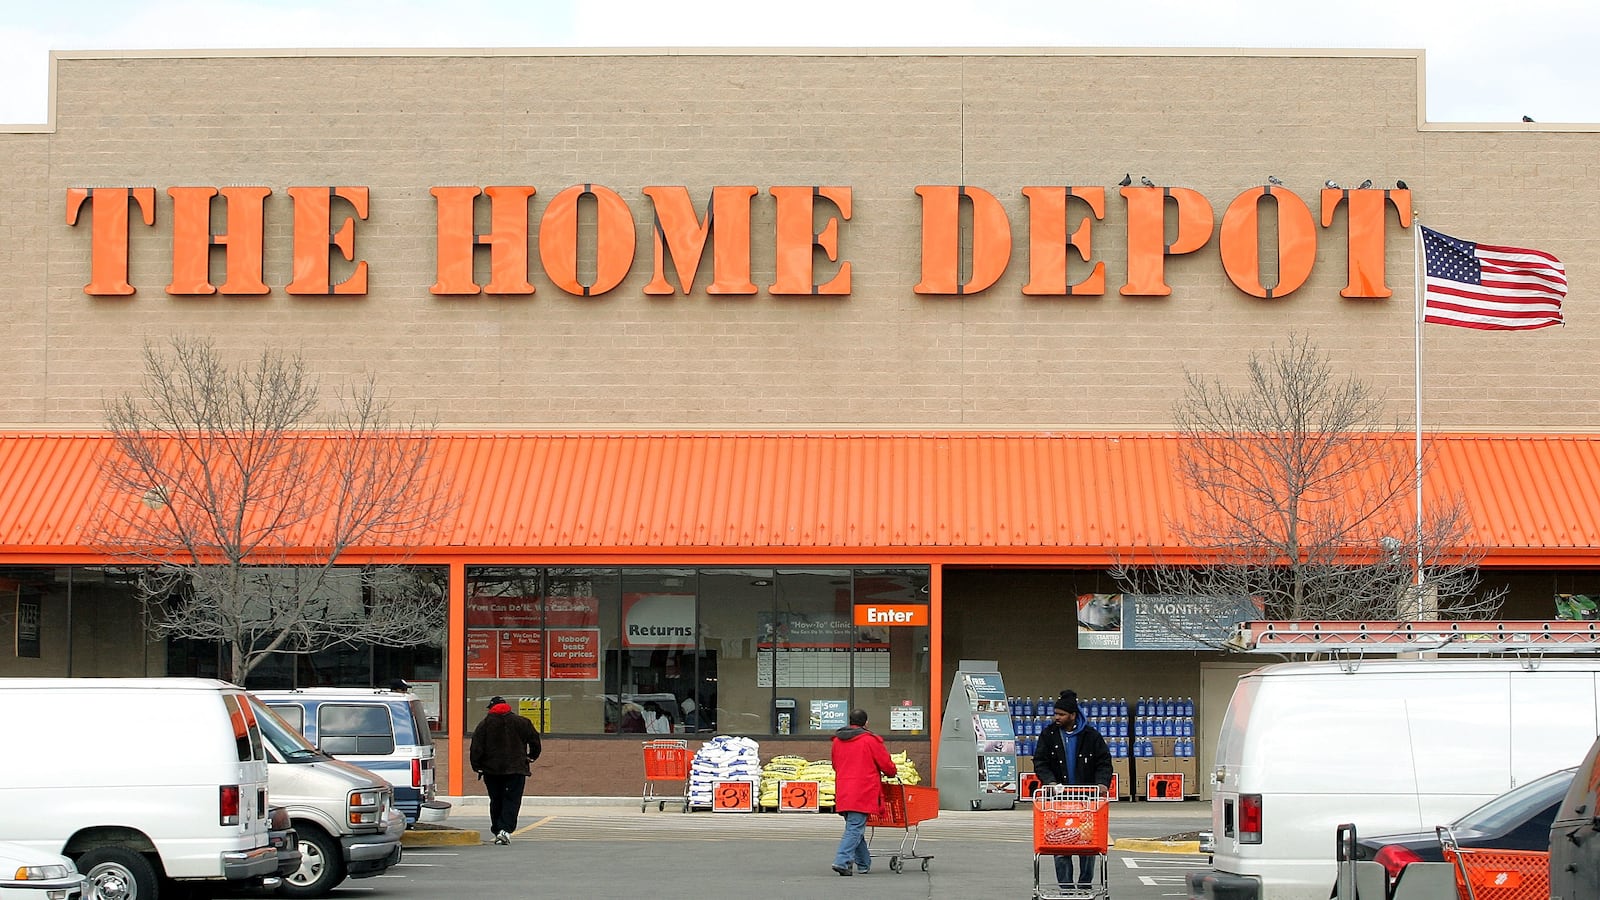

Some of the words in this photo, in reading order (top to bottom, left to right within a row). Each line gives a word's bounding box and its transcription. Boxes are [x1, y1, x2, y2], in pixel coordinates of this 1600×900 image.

[66, 185, 370, 296] THE
[428, 183, 853, 297] HOME
[913, 184, 1412, 298] DEPOT
[471, 604, 489, 612] You
[490, 604, 507, 612] Can
[1134, 603, 1149, 615] 12
[866, 607, 915, 623] Enter
[628, 624, 692, 637] Returns
[558, 635, 590, 645] Nobody
[980, 718, 1000, 729] FREE
